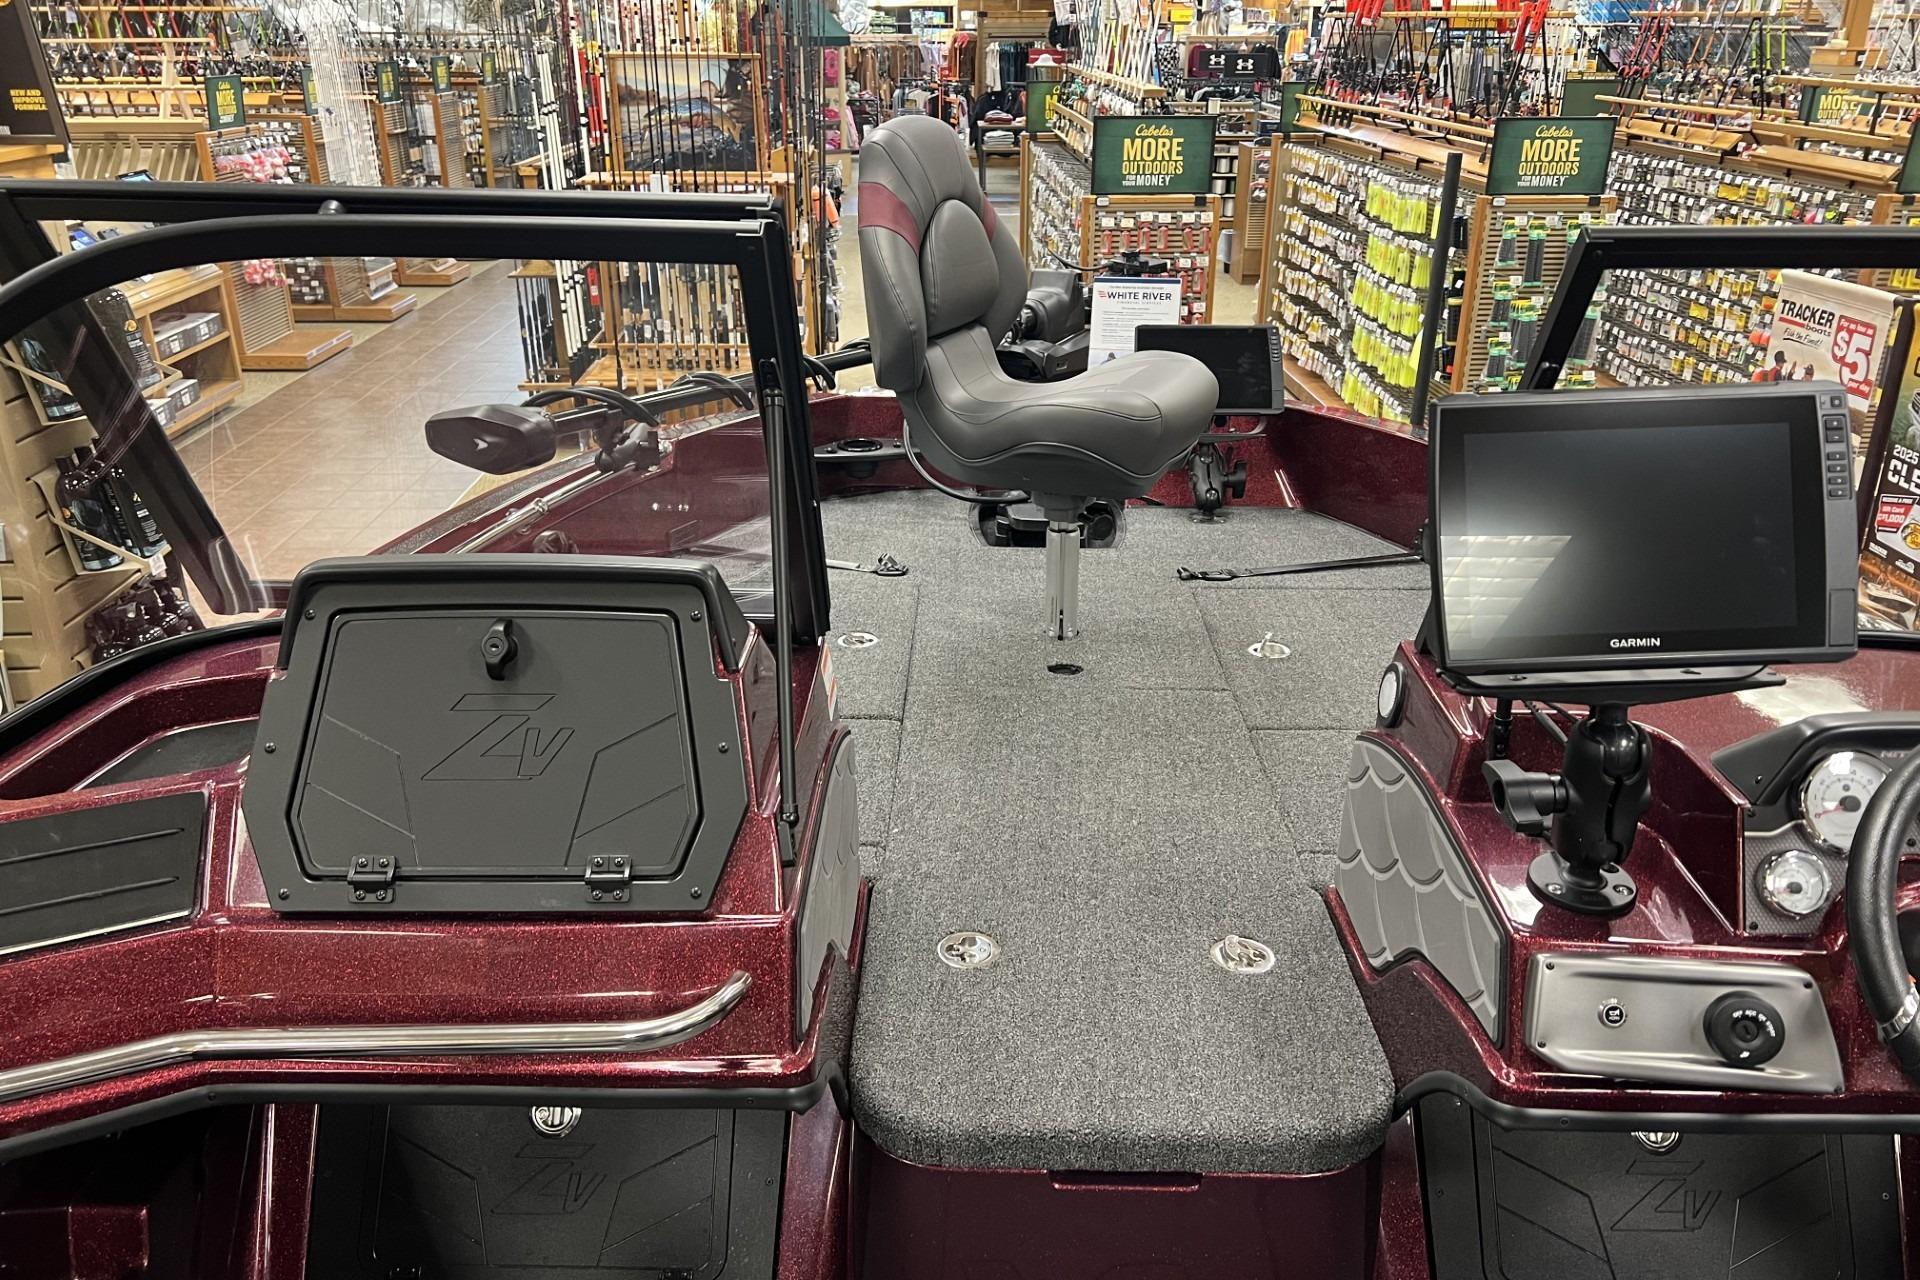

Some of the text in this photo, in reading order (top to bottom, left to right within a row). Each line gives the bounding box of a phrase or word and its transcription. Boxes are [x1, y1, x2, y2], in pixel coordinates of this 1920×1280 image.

[10, 89, 42, 97] NEW AND
[1123, 137, 1185, 161] MORE
[1520, 138, 1584, 162] MORE
[1122, 160, 1184, 175] OUTDOORS
[1518, 161, 1580, 176] OUTDOORS
[1107, 291, 1172, 301] WHITE RIVER
[1780, 298, 1836, 329] TRACKER
[1804, 323, 1833, 337] boats
[1833, 328, 1873, 385] $5
[1893, 444, 1920, 466] 2025
[1609, 637, 1661, 648] GARMIN
